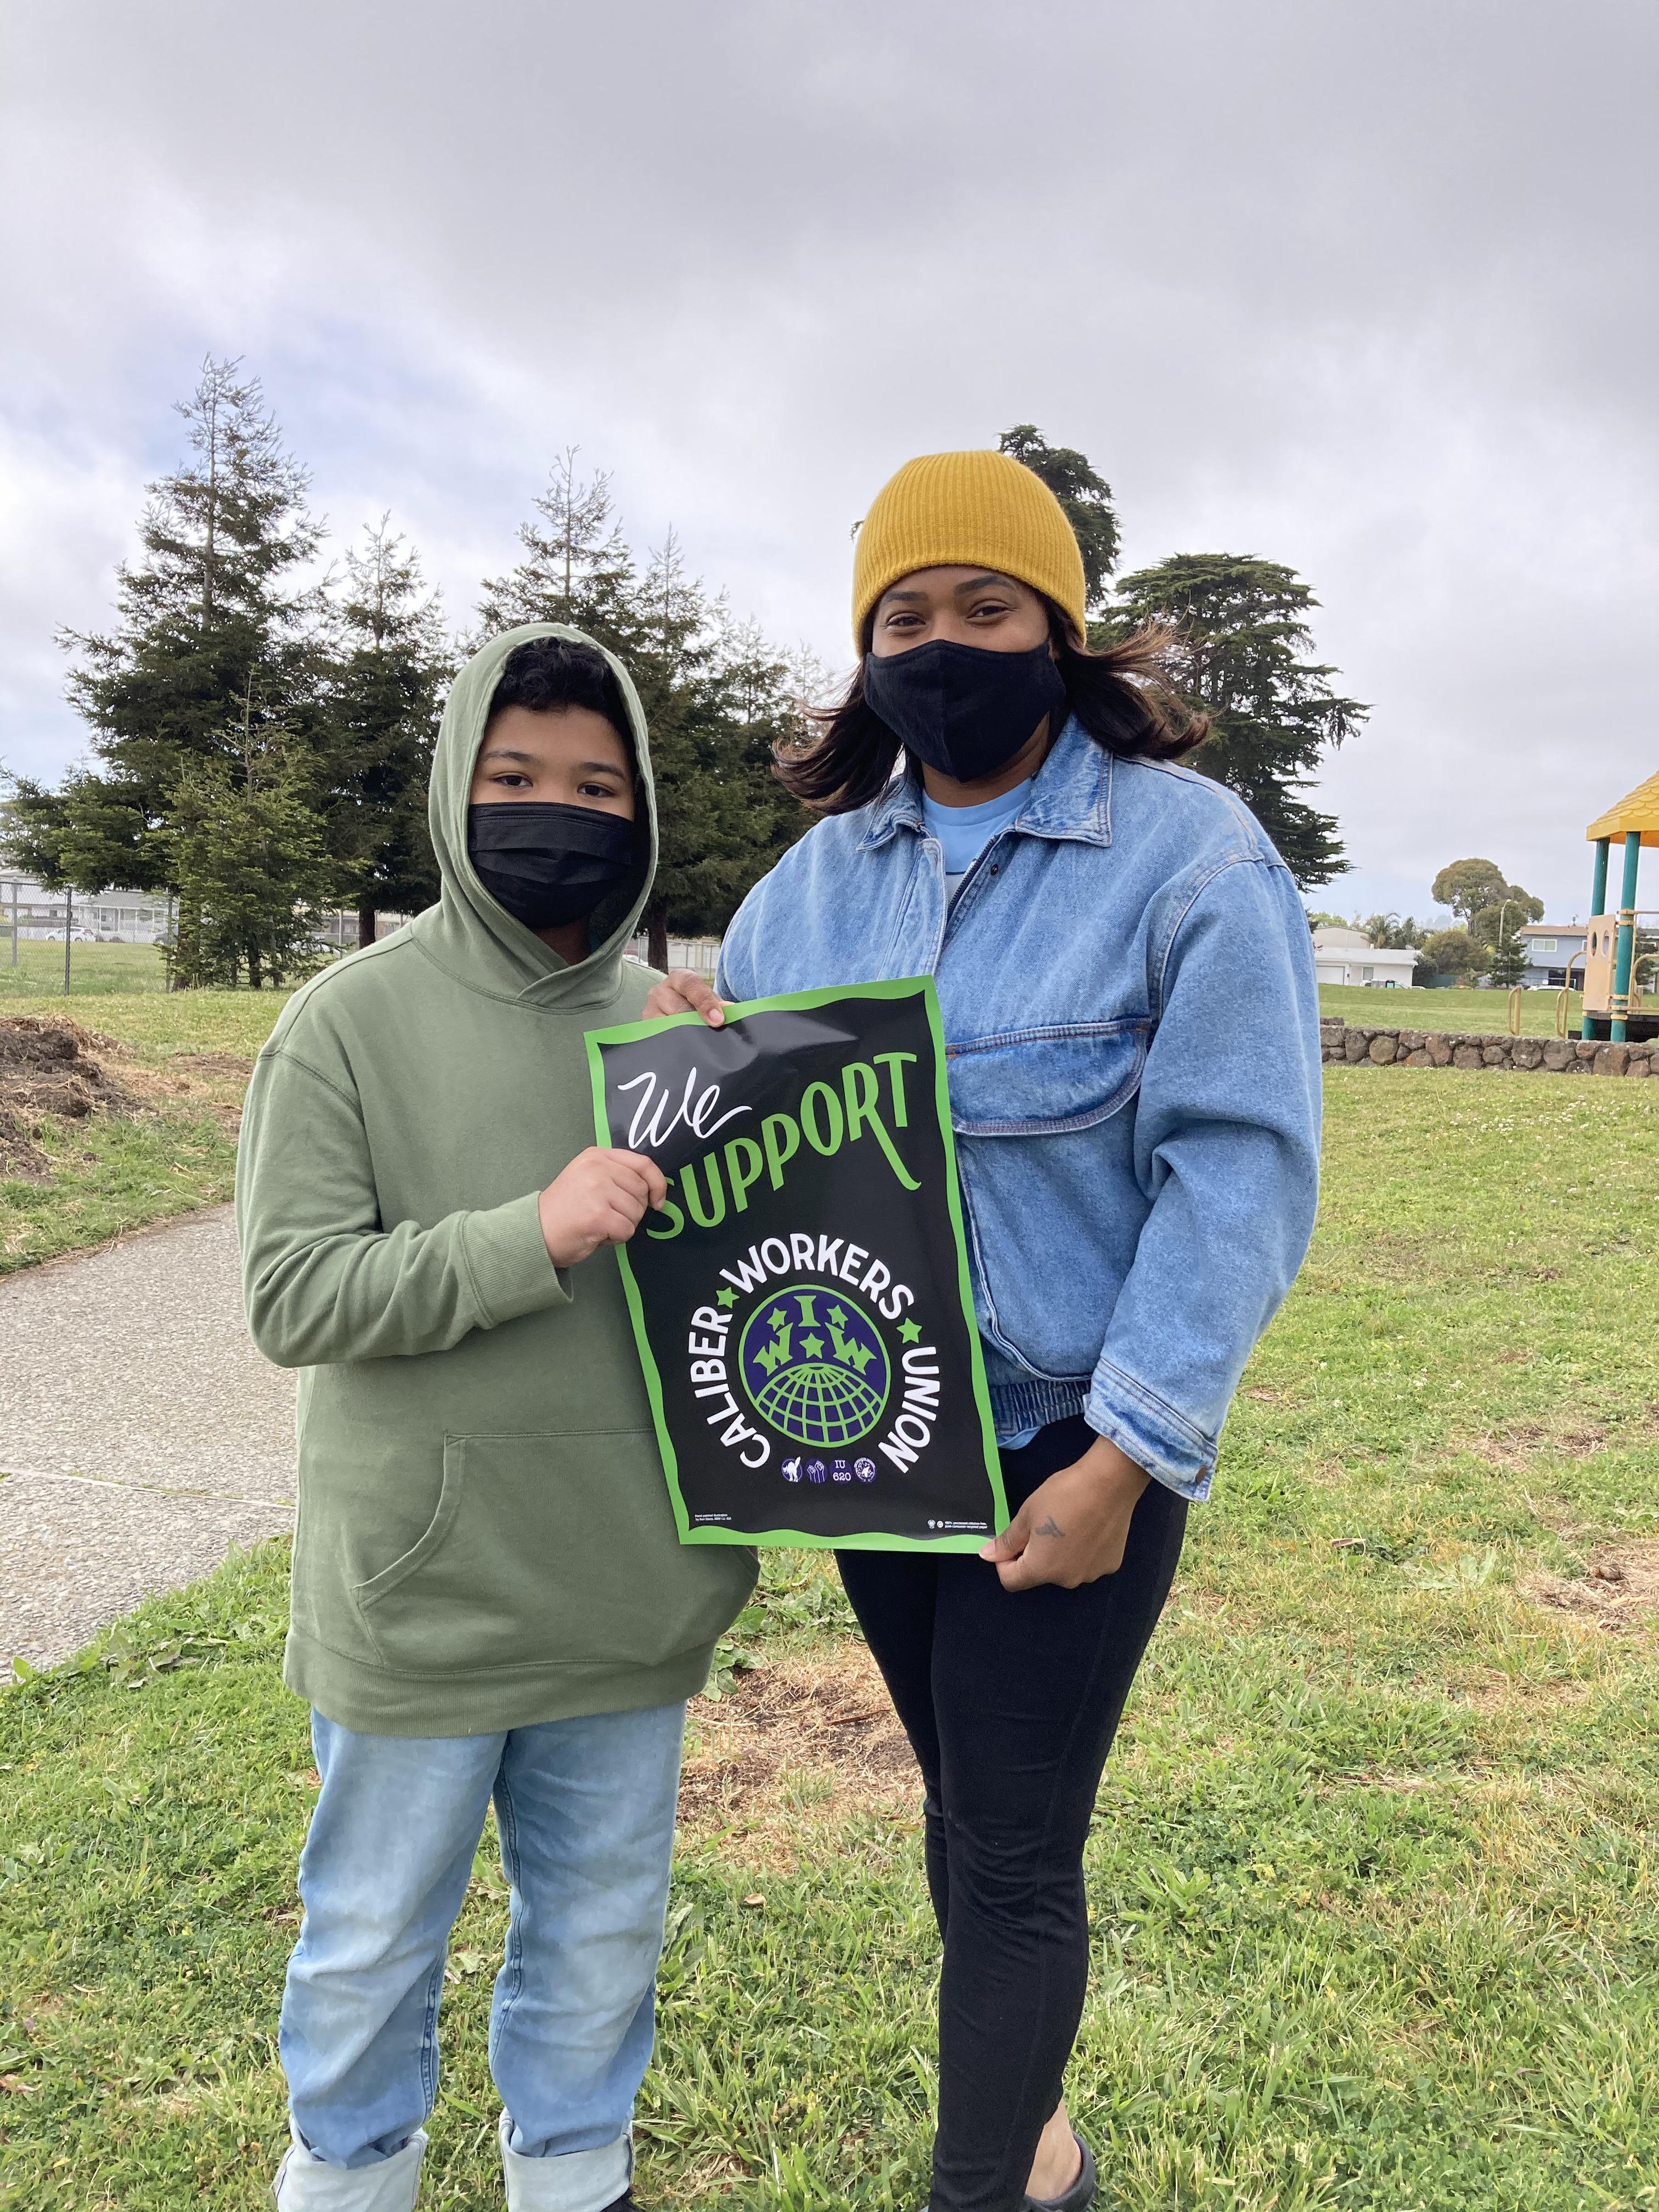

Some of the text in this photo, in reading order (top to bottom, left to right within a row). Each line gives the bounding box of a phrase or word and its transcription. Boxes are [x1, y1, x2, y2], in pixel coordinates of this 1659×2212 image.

[618, 1066, 752, 1149] We
[646, 1052, 922, 1239] SUPPORT
[689, 1233, 940, 1474] CALIBER WORKERS UNION
[833, 1472, 851, 1481] 620
[834, 1459, 845, 1469] IU
